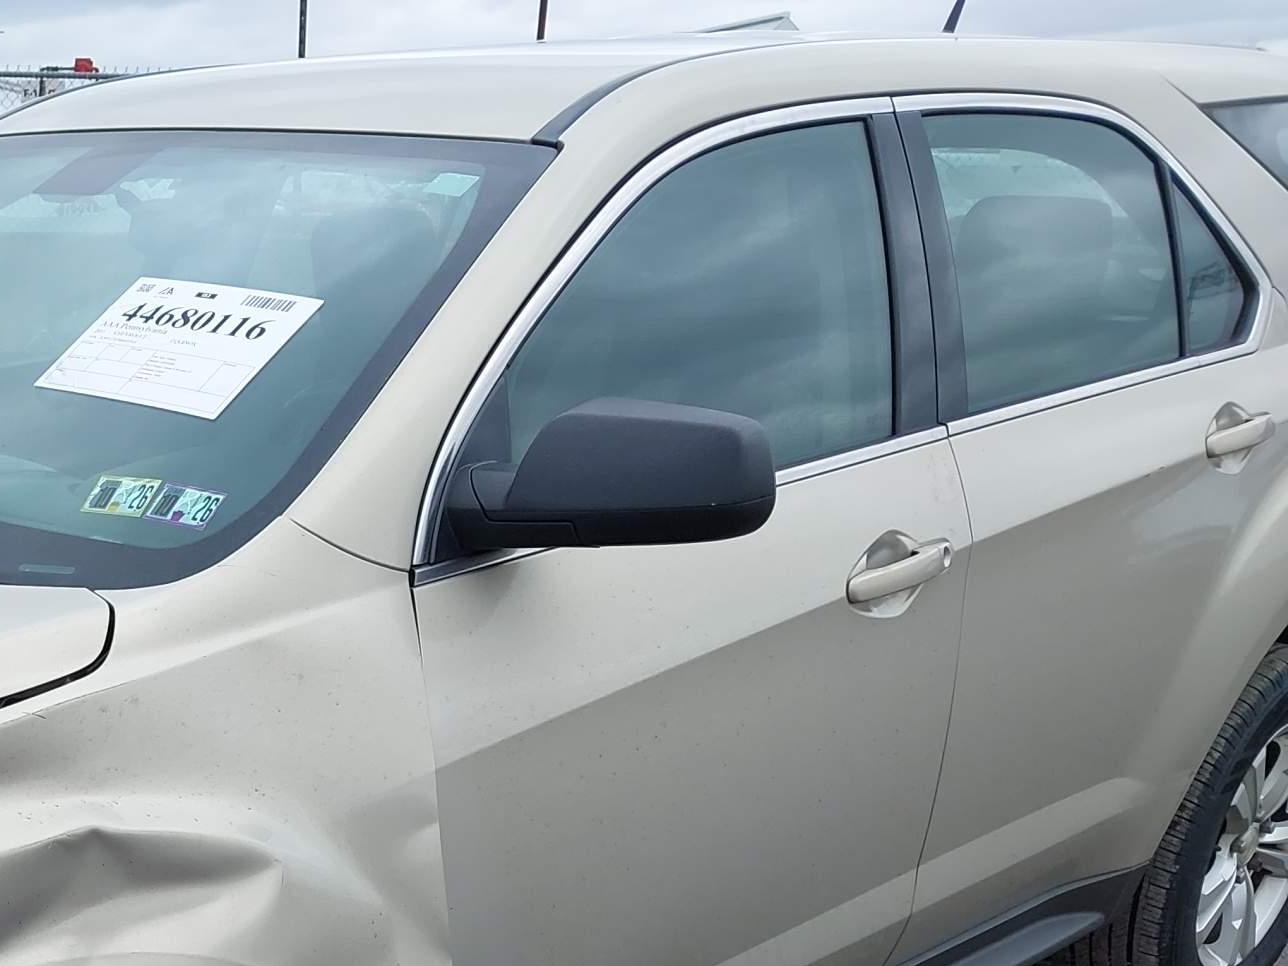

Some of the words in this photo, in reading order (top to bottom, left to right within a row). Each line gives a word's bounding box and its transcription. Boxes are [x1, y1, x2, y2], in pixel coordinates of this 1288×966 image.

[121, 302, 276, 340] 44680116
[128, 484, 155, 510] 26
[191, 496, 221, 523] 26
